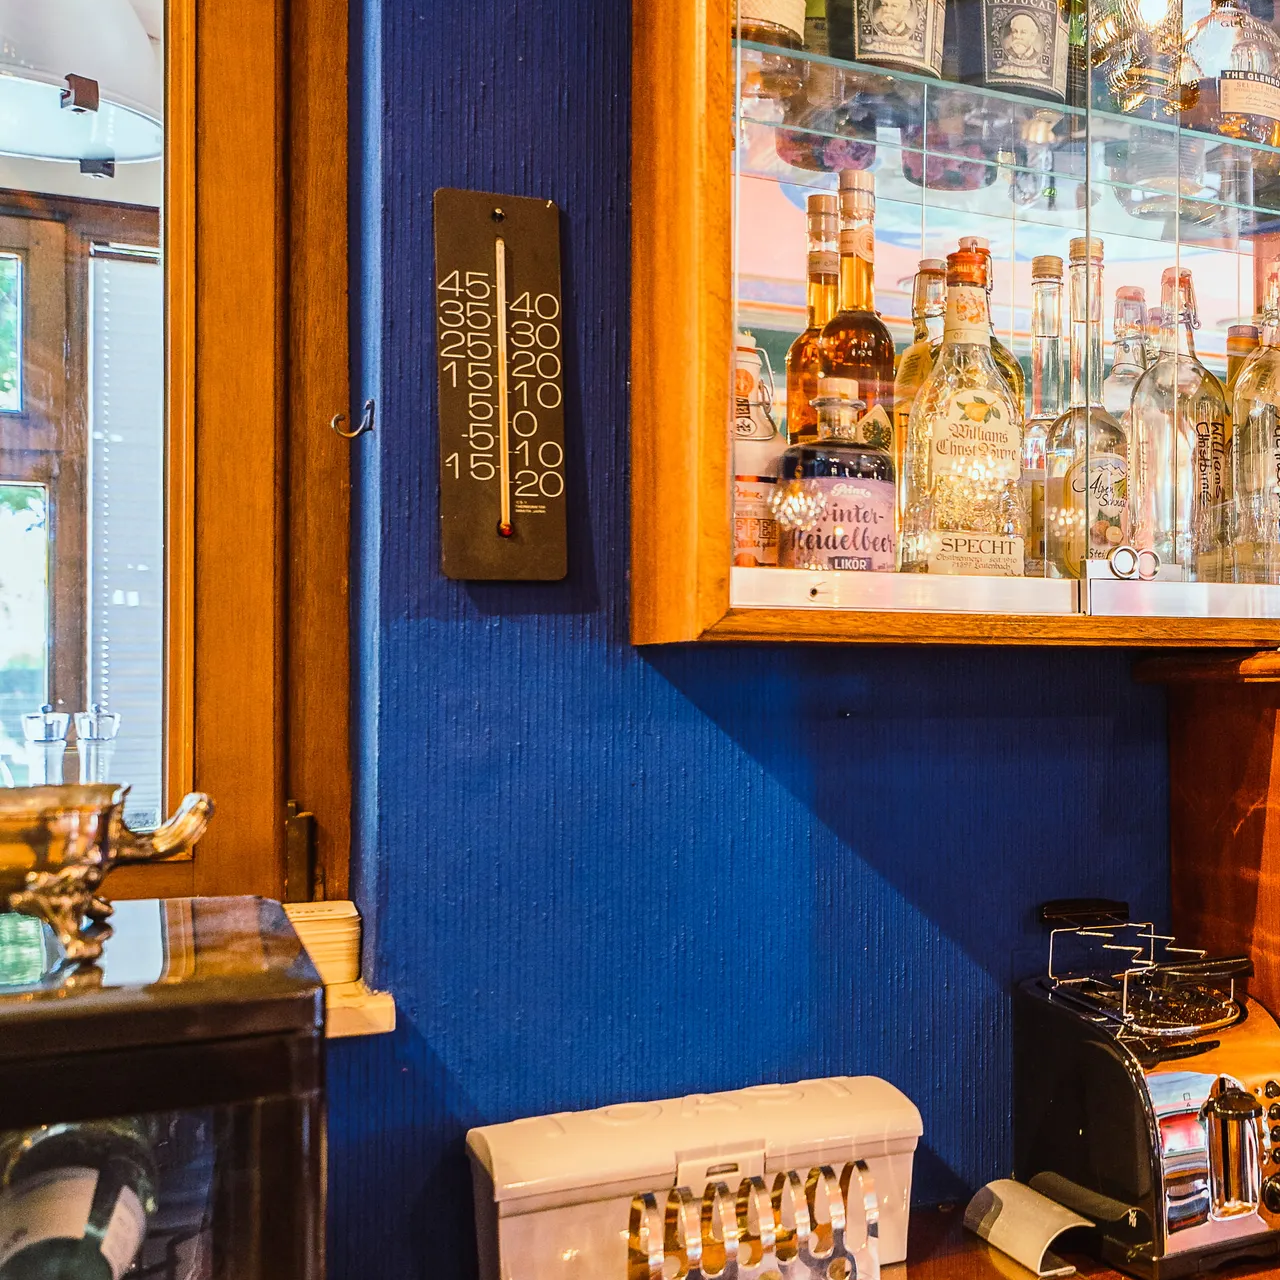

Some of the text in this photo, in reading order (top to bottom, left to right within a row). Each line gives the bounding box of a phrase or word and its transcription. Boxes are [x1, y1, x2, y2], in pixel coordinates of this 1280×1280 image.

[1225, 72, 1245, 80] THE
[438, 271, 491, 299] 45
[439, 301, 491, 329] 35
[510, 292, 560, 320] 40
[440, 330, 492, 359] 25
[511, 322, 560, 349] 30
[443, 361, 492, 390] 15
[512, 352, 561, 378] 20
[468, 392, 493, 420] 5
[514, 381, 562, 409] 10
[513, 410, 538, 437] 0
[949, 423, 1008, 443] Williams
[936, 439, 1017, 461] Christ Birne
[1211, 423, 1225, 499] Williams
[831, 483, 872, 497] Prinz
[1082, 474, 1114, 499] Alpen
[818, 502, 884, 524] inter-
[941, 538, 1016, 555] SPECHT
[834, 558, 866, 570] LIKÖR
